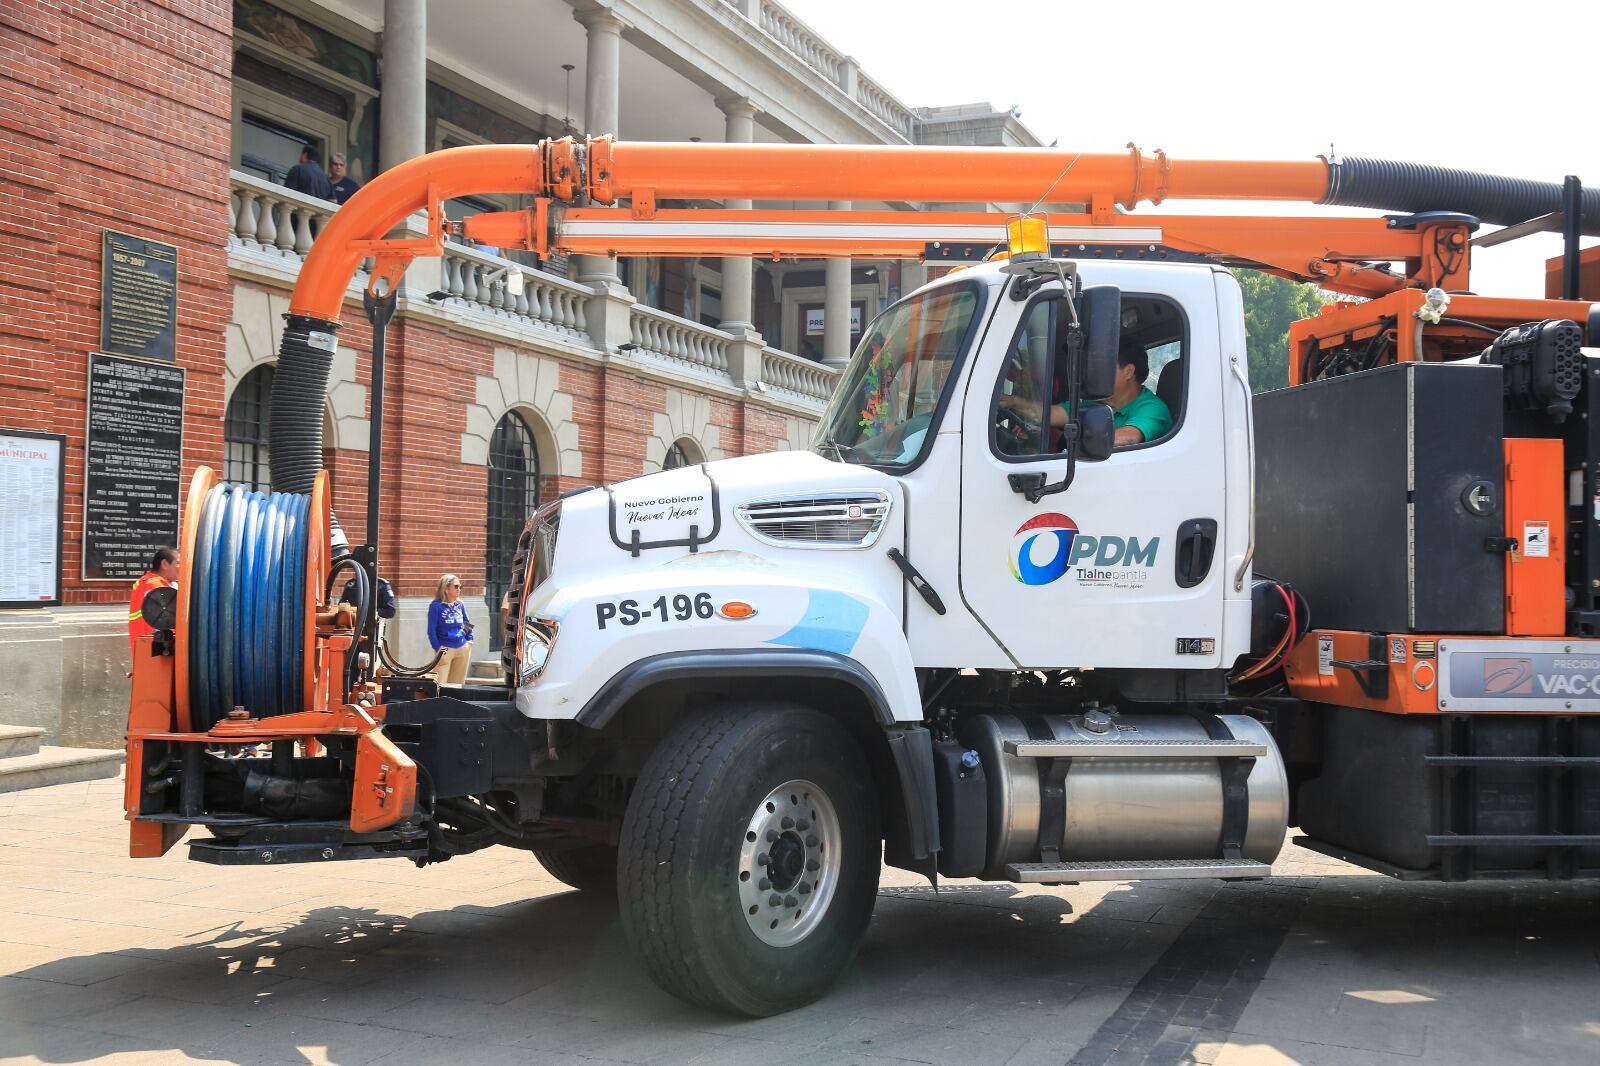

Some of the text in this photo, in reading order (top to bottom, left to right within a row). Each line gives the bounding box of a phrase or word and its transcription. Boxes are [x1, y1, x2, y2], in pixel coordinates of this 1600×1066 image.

[624, 495, 704, 508] Nuevo Gobierno
[626, 506, 699, 524] Nuevas Ideas
[1076, 568, 1147, 584] Tlalnepantla
[596, 592, 714, 630] PS-196
